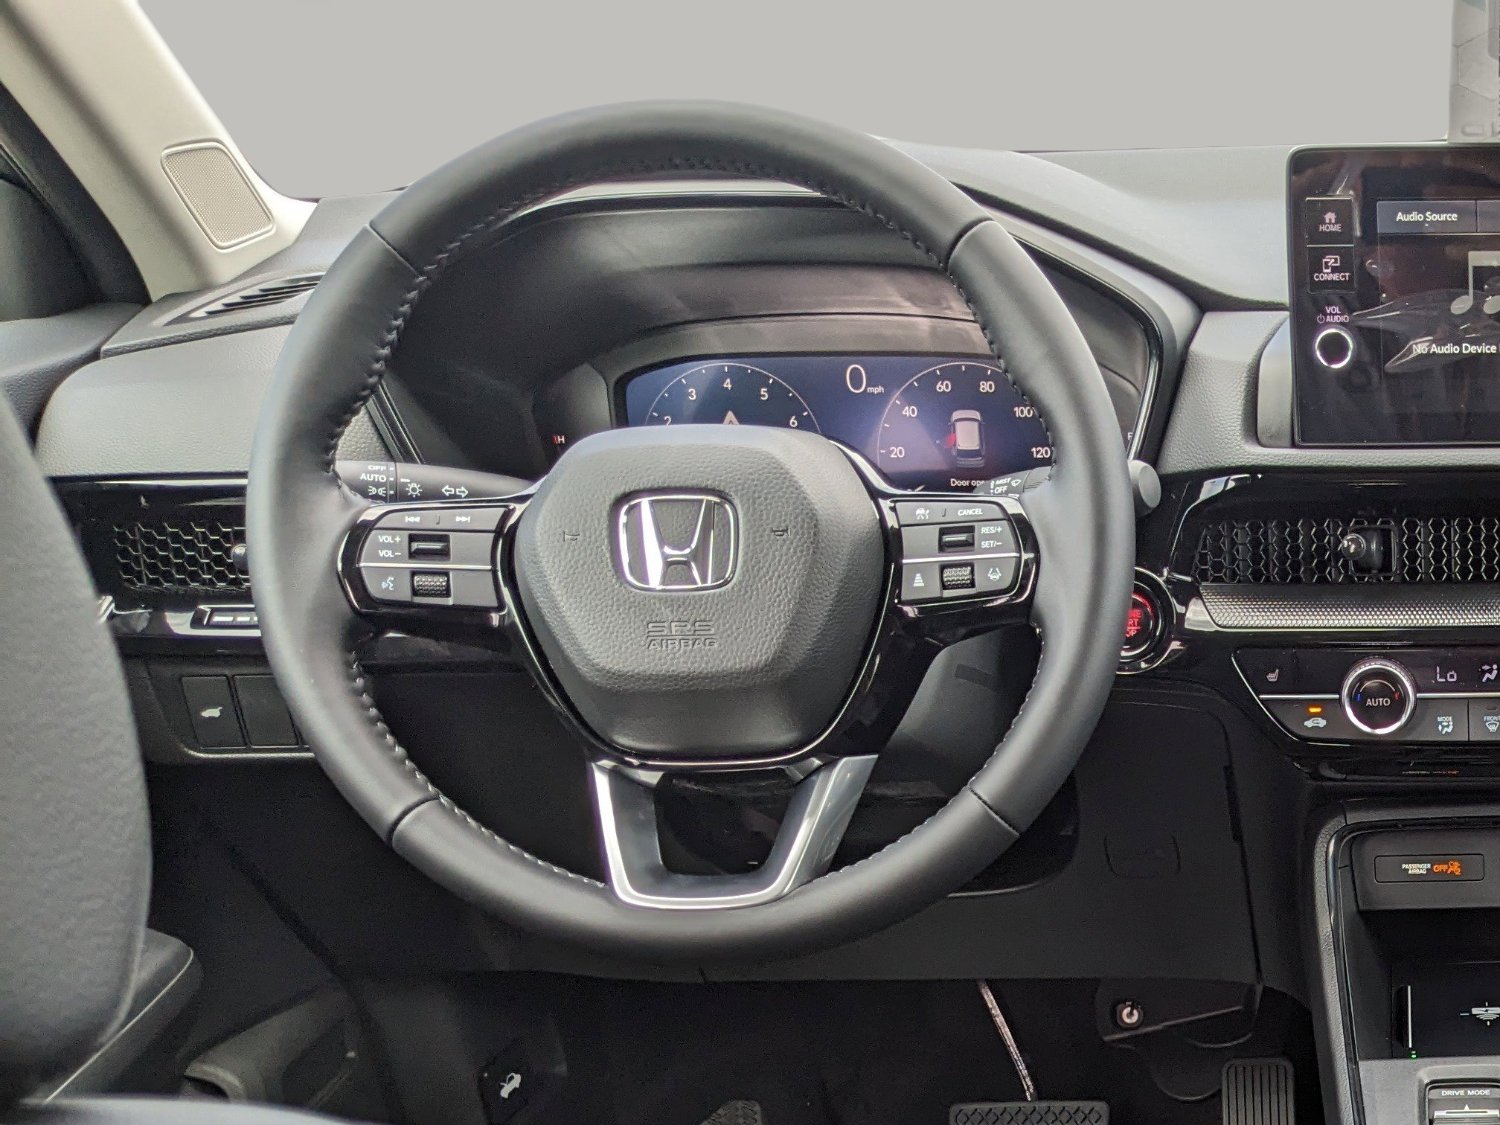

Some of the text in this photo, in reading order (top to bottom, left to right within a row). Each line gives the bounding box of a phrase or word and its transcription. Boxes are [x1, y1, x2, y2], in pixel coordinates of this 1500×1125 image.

[1396, 212, 1458, 222] Audio Source
[1318, 224, 1342, 232] HOME
[1314, 273, 1350, 281] CONNECT
[1325, 306, 1341, 314] VOL
[1326, 316, 1350, 324] AUDIO
[1412, 343, 1428, 354] No
[1430, 343, 1460, 354] Audio
[1462, 342, 1497, 354] Device
[723, 378, 732, 390] 4
[846, 364, 884, 394] 0 mph
[936, 380, 952, 392] 60
[980, 380, 995, 392] 80
[688, 388, 697, 400] 3
[760, 388, 768, 400] 5
[902, 406, 918, 418] 40
[1014, 406, 1033, 418] 100
[789, 416, 798, 427] 6
[890, 446, 905, 458] 20
[1030, 447, 1050, 458] 120
[360, 473, 387, 482] AUTO
[950, 478, 970, 487] Door
[994, 486, 1008, 494] OFF
[957, 508, 984, 517] CANCEL
[646, 620, 716, 635] SRS
[647, 638, 718, 650] AIRBAG
[1366, 698, 1391, 707] AUTO
[1432, 864, 1449, 872] OFF
